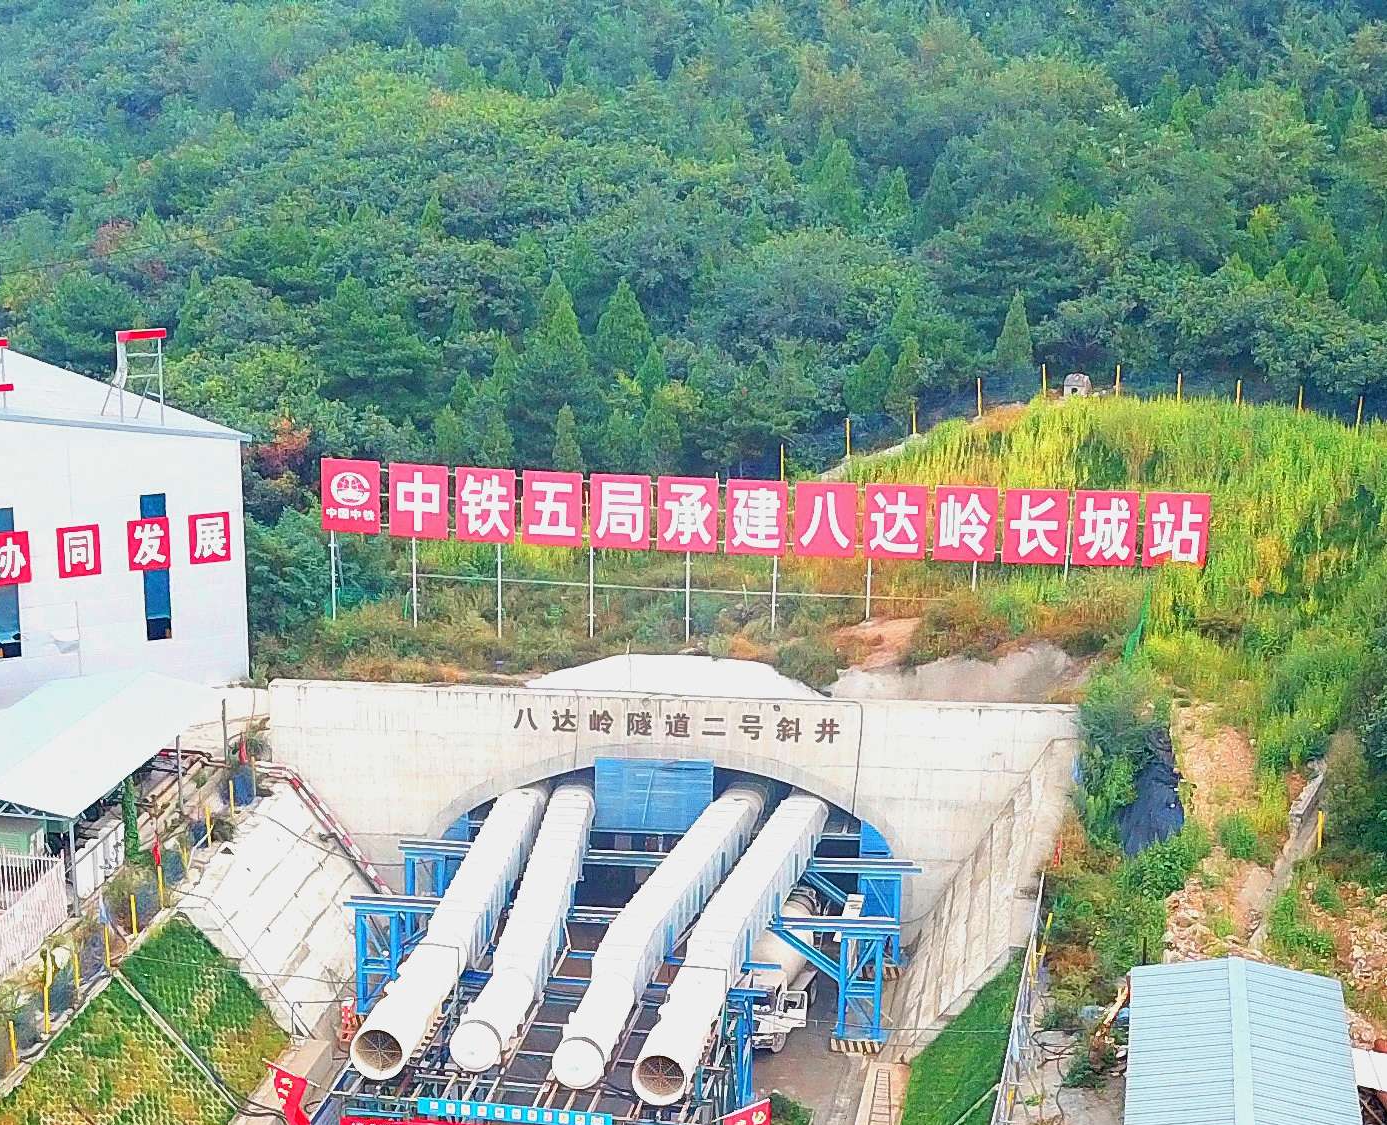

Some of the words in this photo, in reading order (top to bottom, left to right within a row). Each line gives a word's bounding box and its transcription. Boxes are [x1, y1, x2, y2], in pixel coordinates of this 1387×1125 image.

[325, 507, 375, 521] 中国中铁
[396, 471, 1204, 562] 中铁五局承建八达岭长城站
[513, 707, 841, 743] 八达岭隧道二号斜井
